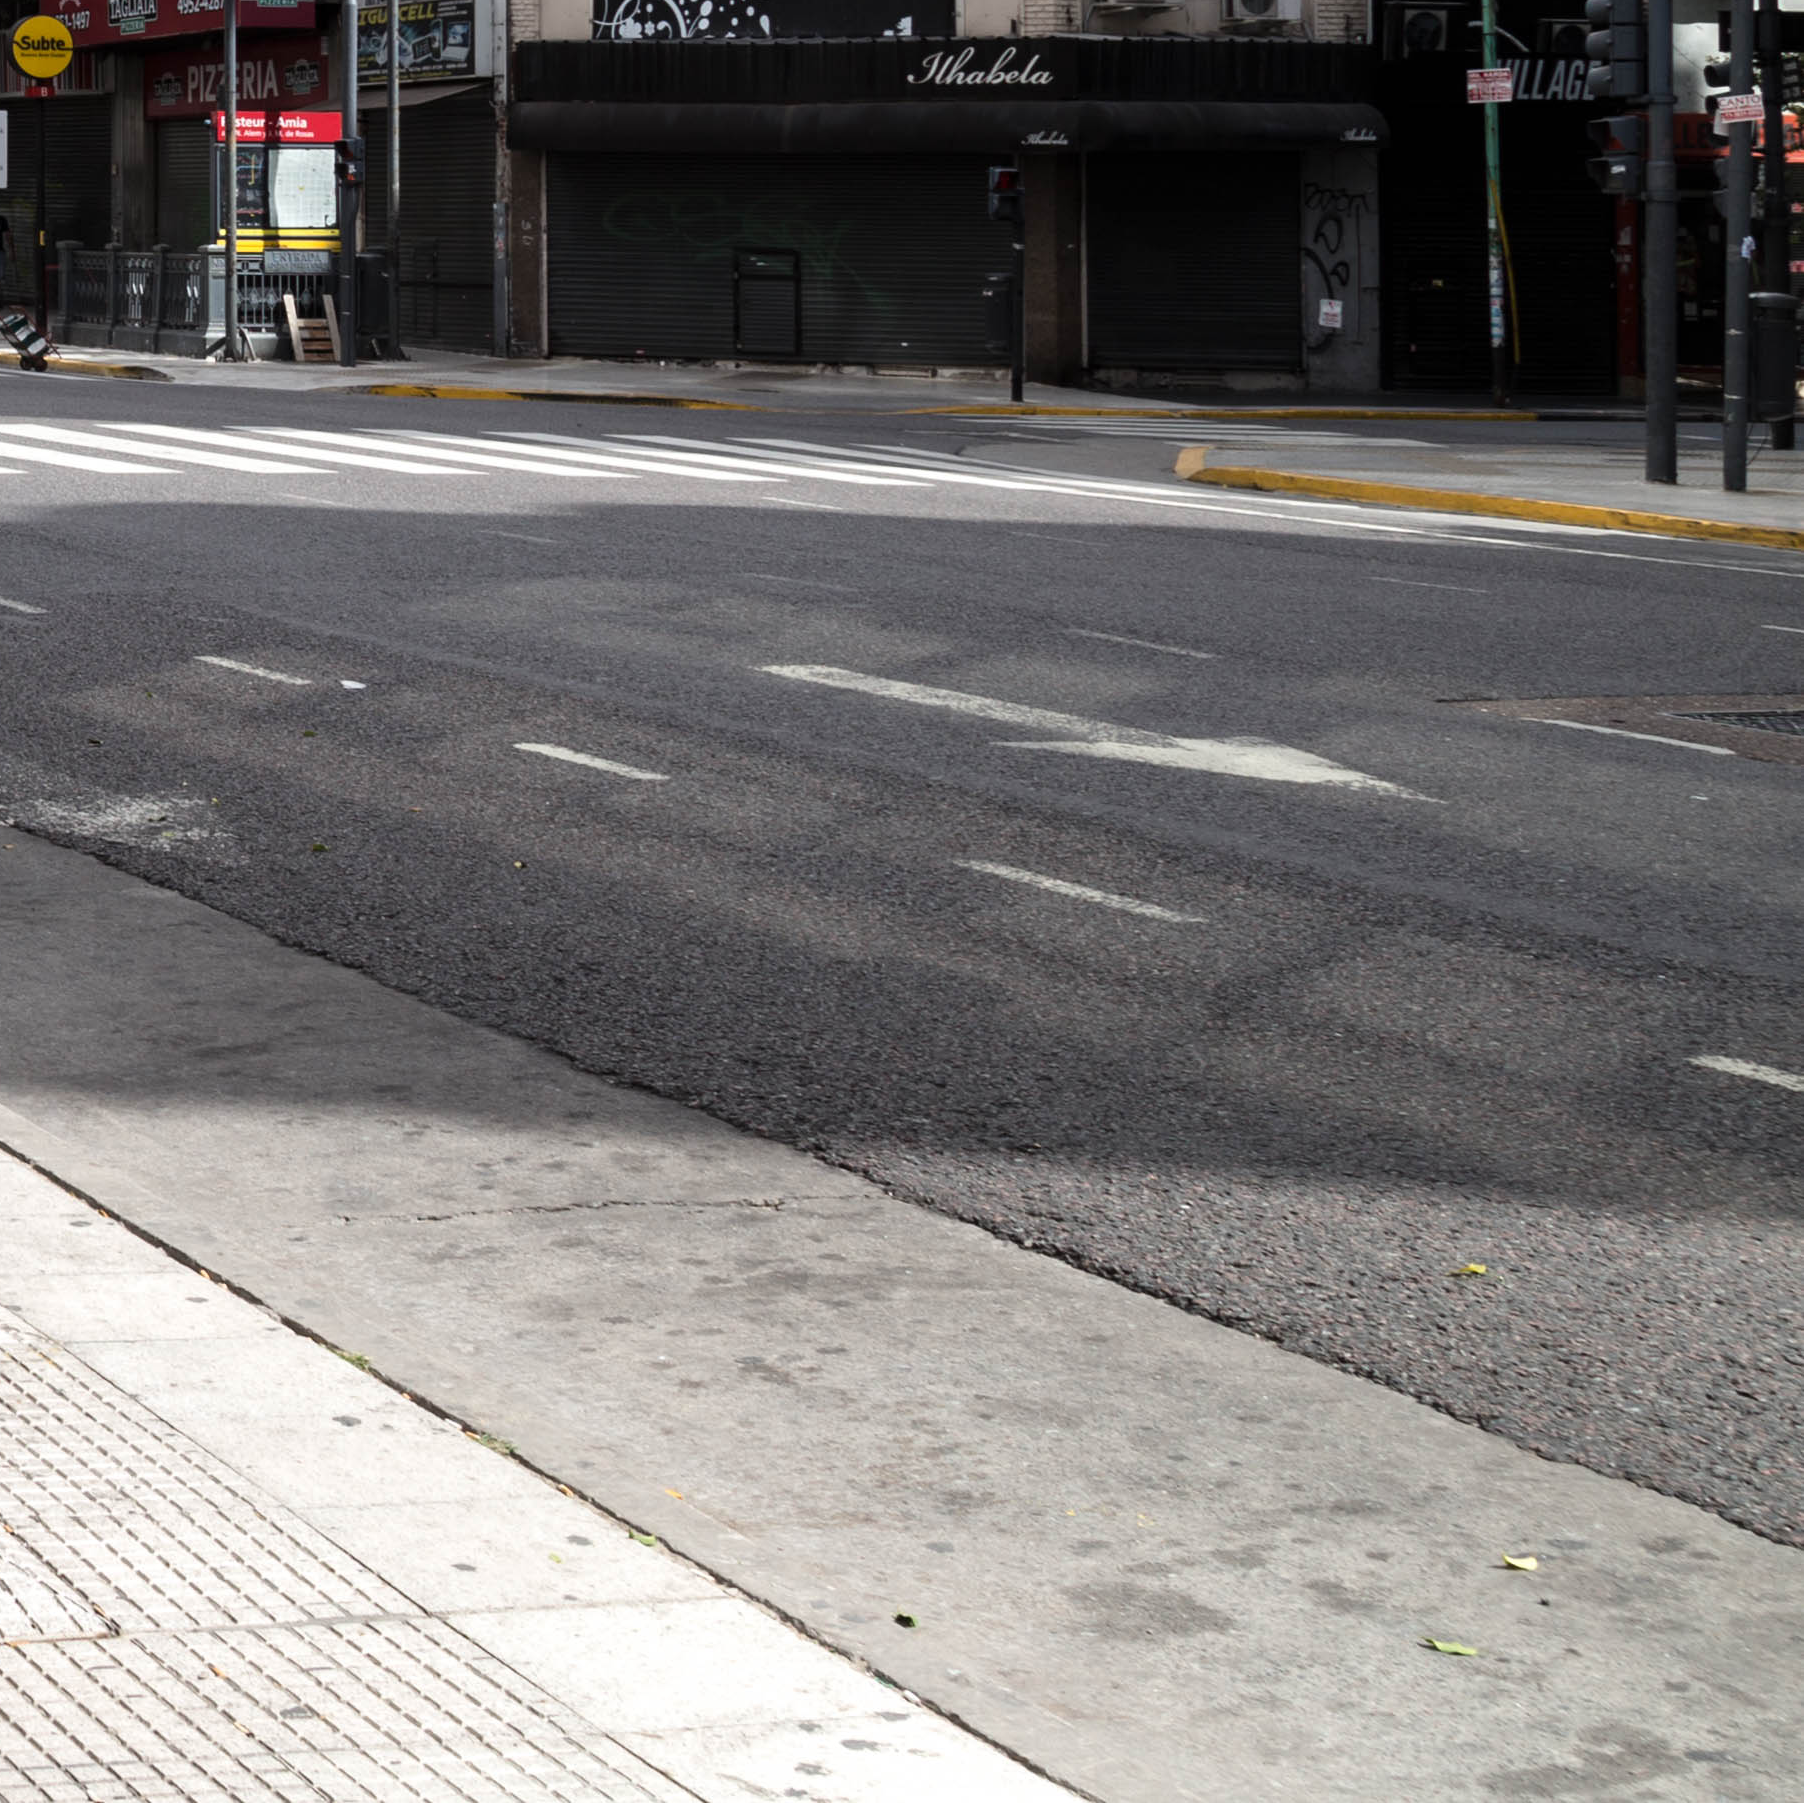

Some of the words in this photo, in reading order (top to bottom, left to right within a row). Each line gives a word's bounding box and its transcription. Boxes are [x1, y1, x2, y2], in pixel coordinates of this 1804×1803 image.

[20, 35, 66, 51] Subte
[906, 45, 1054, 86] Ilhabela
[41, 87, 48, 97] B
[276, 116, 308, 129] Amia
